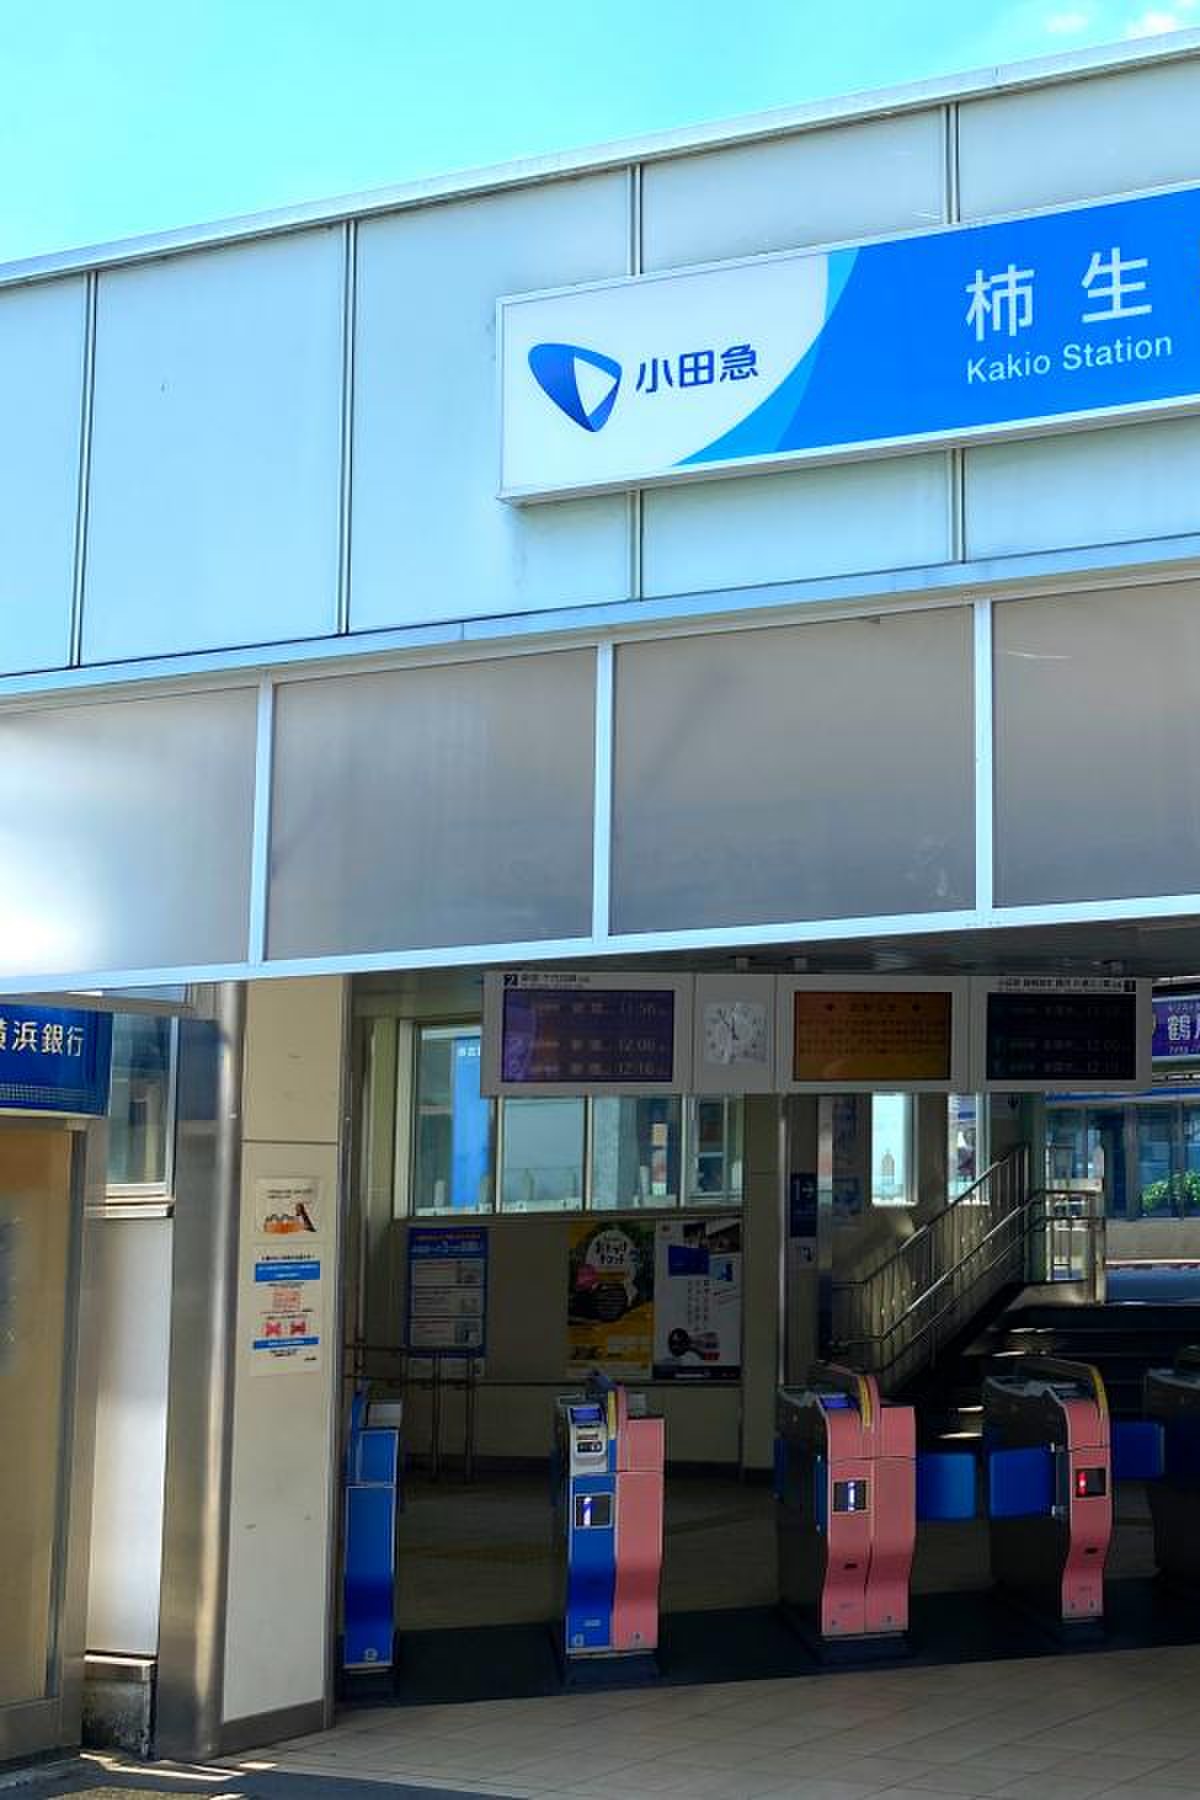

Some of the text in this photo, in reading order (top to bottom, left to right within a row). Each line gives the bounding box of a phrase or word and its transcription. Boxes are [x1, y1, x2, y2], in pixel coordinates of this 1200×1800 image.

[635, 343, 760, 394] 小田急
[966, 336, 1173, 386] Kakio Station
[0, 1018, 84, 1057] 浜銀行
